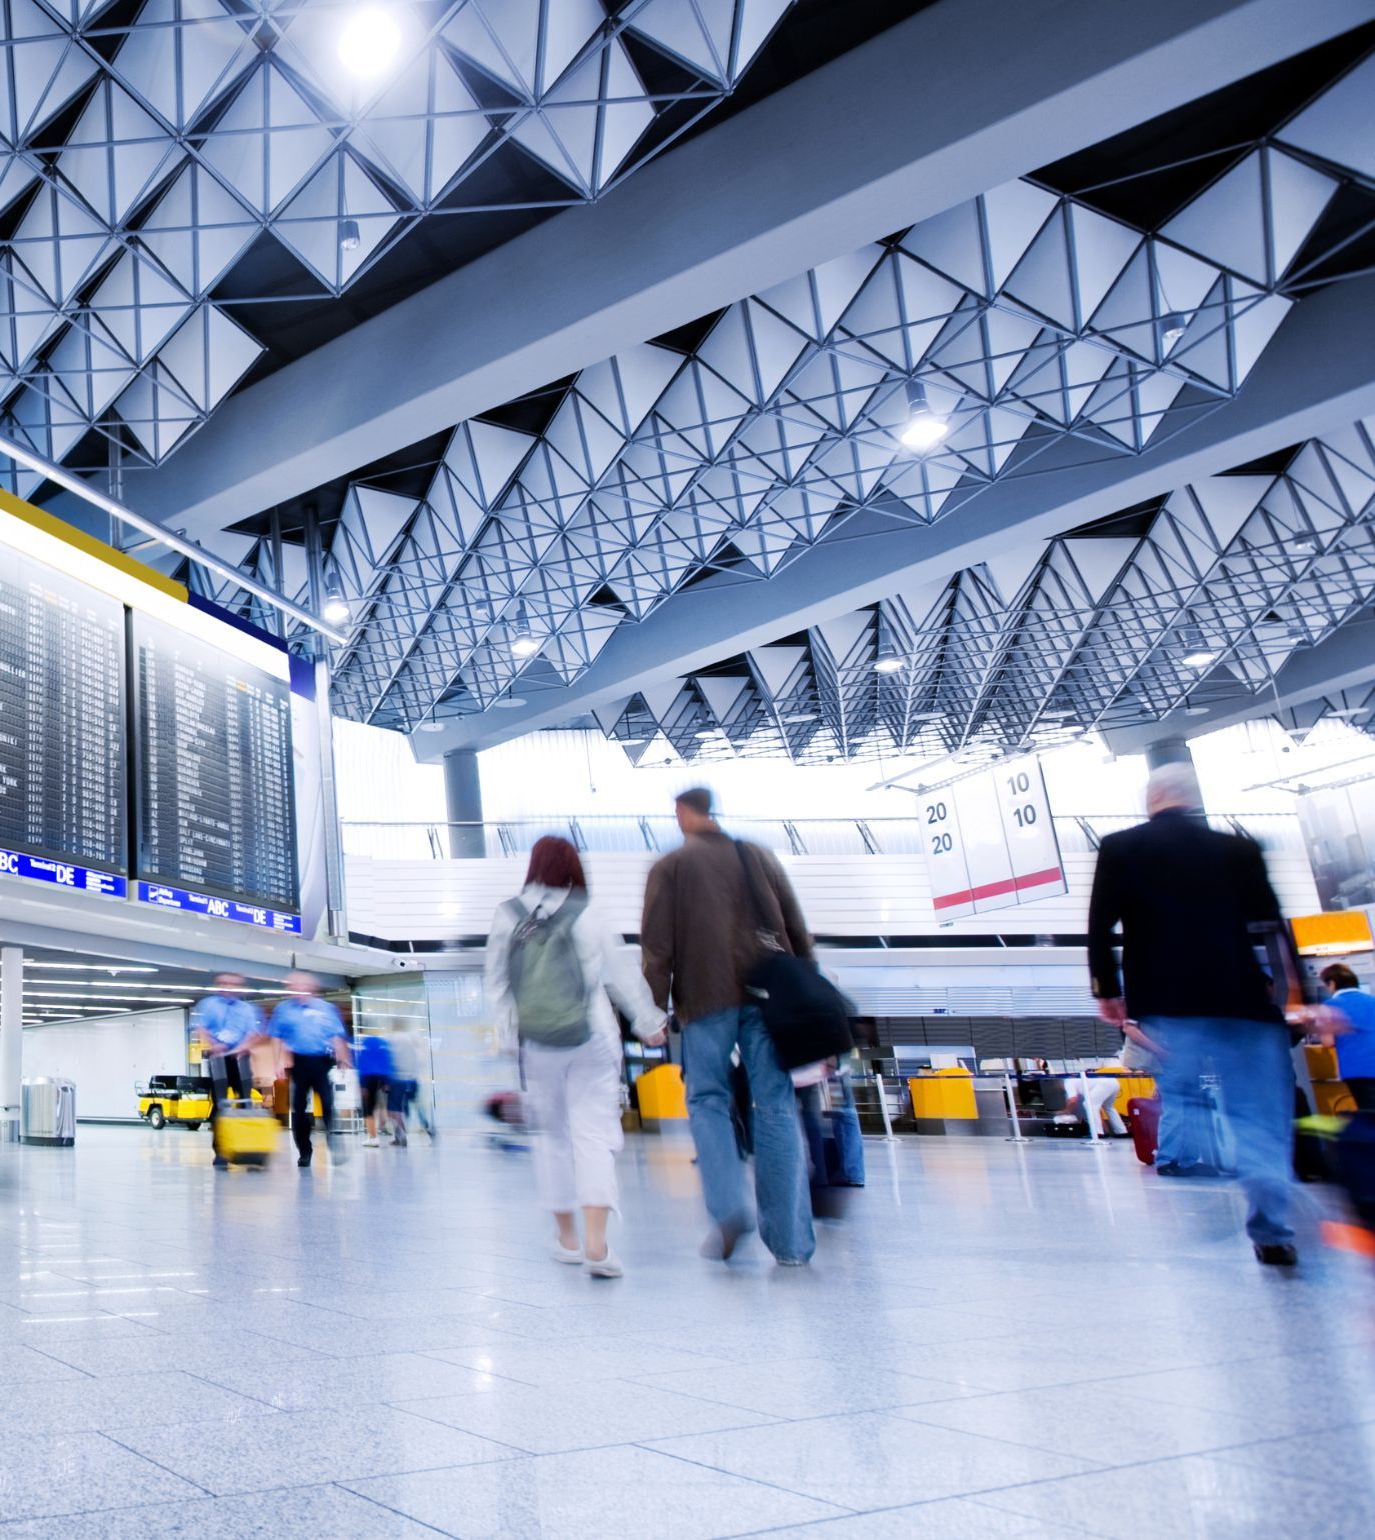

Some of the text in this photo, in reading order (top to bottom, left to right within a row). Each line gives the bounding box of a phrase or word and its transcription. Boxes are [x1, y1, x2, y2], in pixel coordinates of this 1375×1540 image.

[1007, 772, 1030, 795] 10
[926, 802, 947, 824] 20
[1013, 804, 1037, 827] 10
[932, 832, 953, 855] 20
[55, 865, 74, 885] DE
[207, 899, 229, 917] ABC
[253, 909, 266, 925] DE
